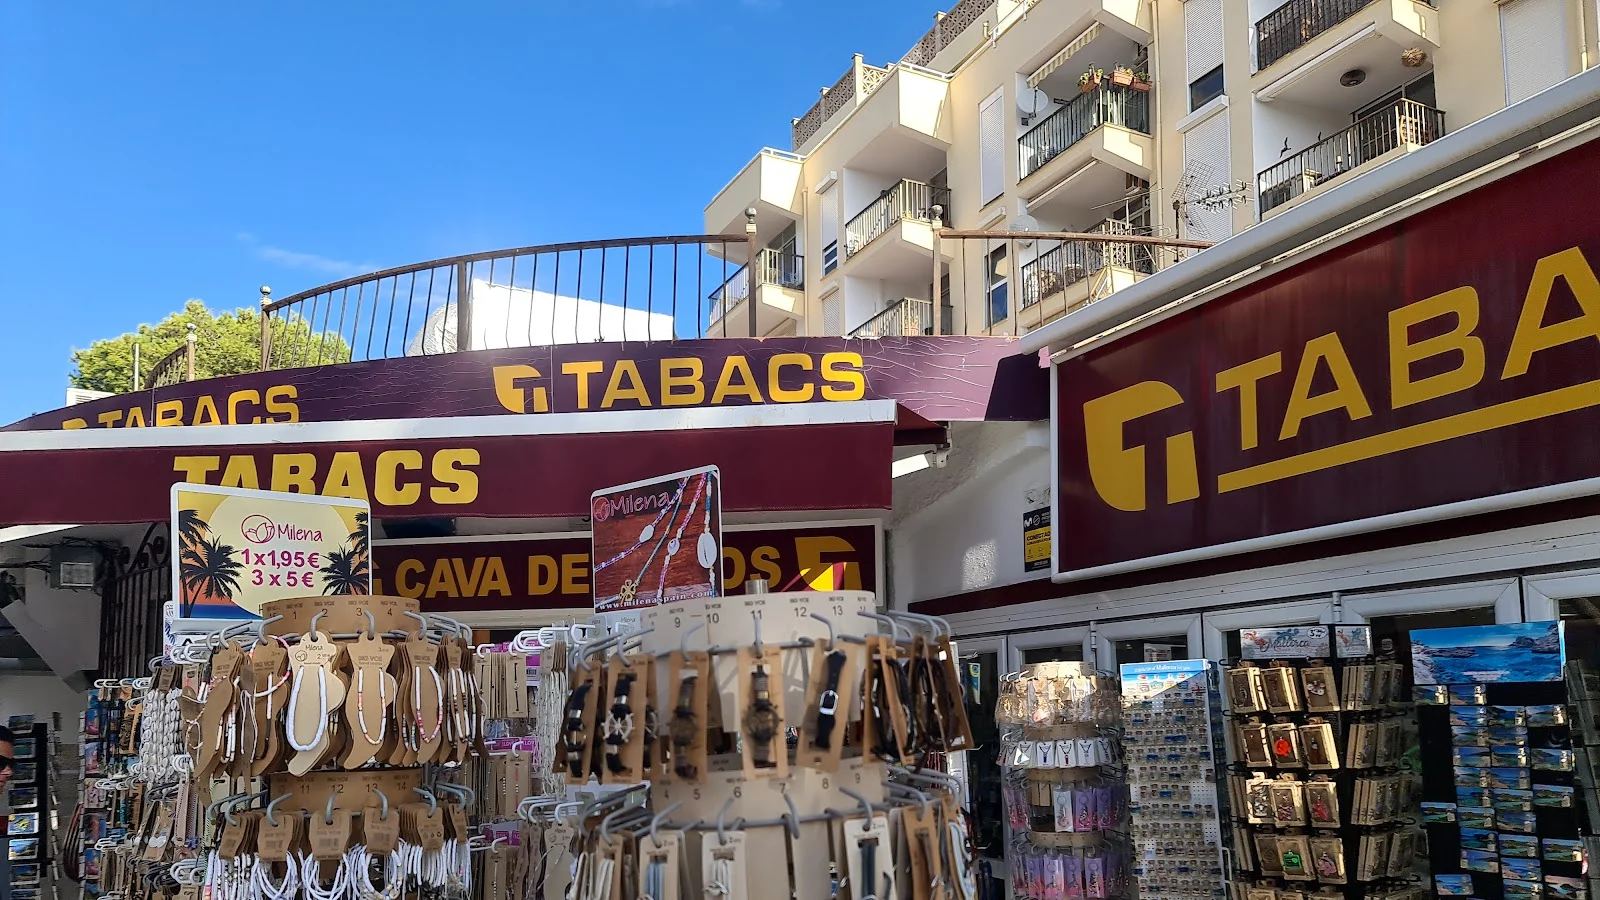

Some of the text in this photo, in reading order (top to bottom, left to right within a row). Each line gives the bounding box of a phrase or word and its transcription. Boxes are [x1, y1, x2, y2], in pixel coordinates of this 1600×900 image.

[1215, 246, 1600, 451] TABA
[561, 351, 865, 410] TABACS
[173, 448, 480, 505] TABACS
[609, 491, 671, 516] Milena
[277, 523, 323, 542] Milena
[395, 556, 512, 599] CAVA
[528, 552, 590, 596] DE
[599, 589, 715, 610] www.milenaspain.com
[292, 611, 297, 620] 1
[356, 608, 363, 617] 3
[387, 608, 393, 617] 4
[794, 606, 807, 617] 12
[832, 605, 843, 616] 13
[674, 617, 681, 628] 9
[706, 612, 720, 624] 10
[1260, 638, 1310, 653] Mallorca
[331, 784, 344, 794] 12
[779, 782, 786, 794] 7
[821, 777, 829, 790] 8
[693, 788, 701, 800] 5
[733, 785, 742, 798] 6
